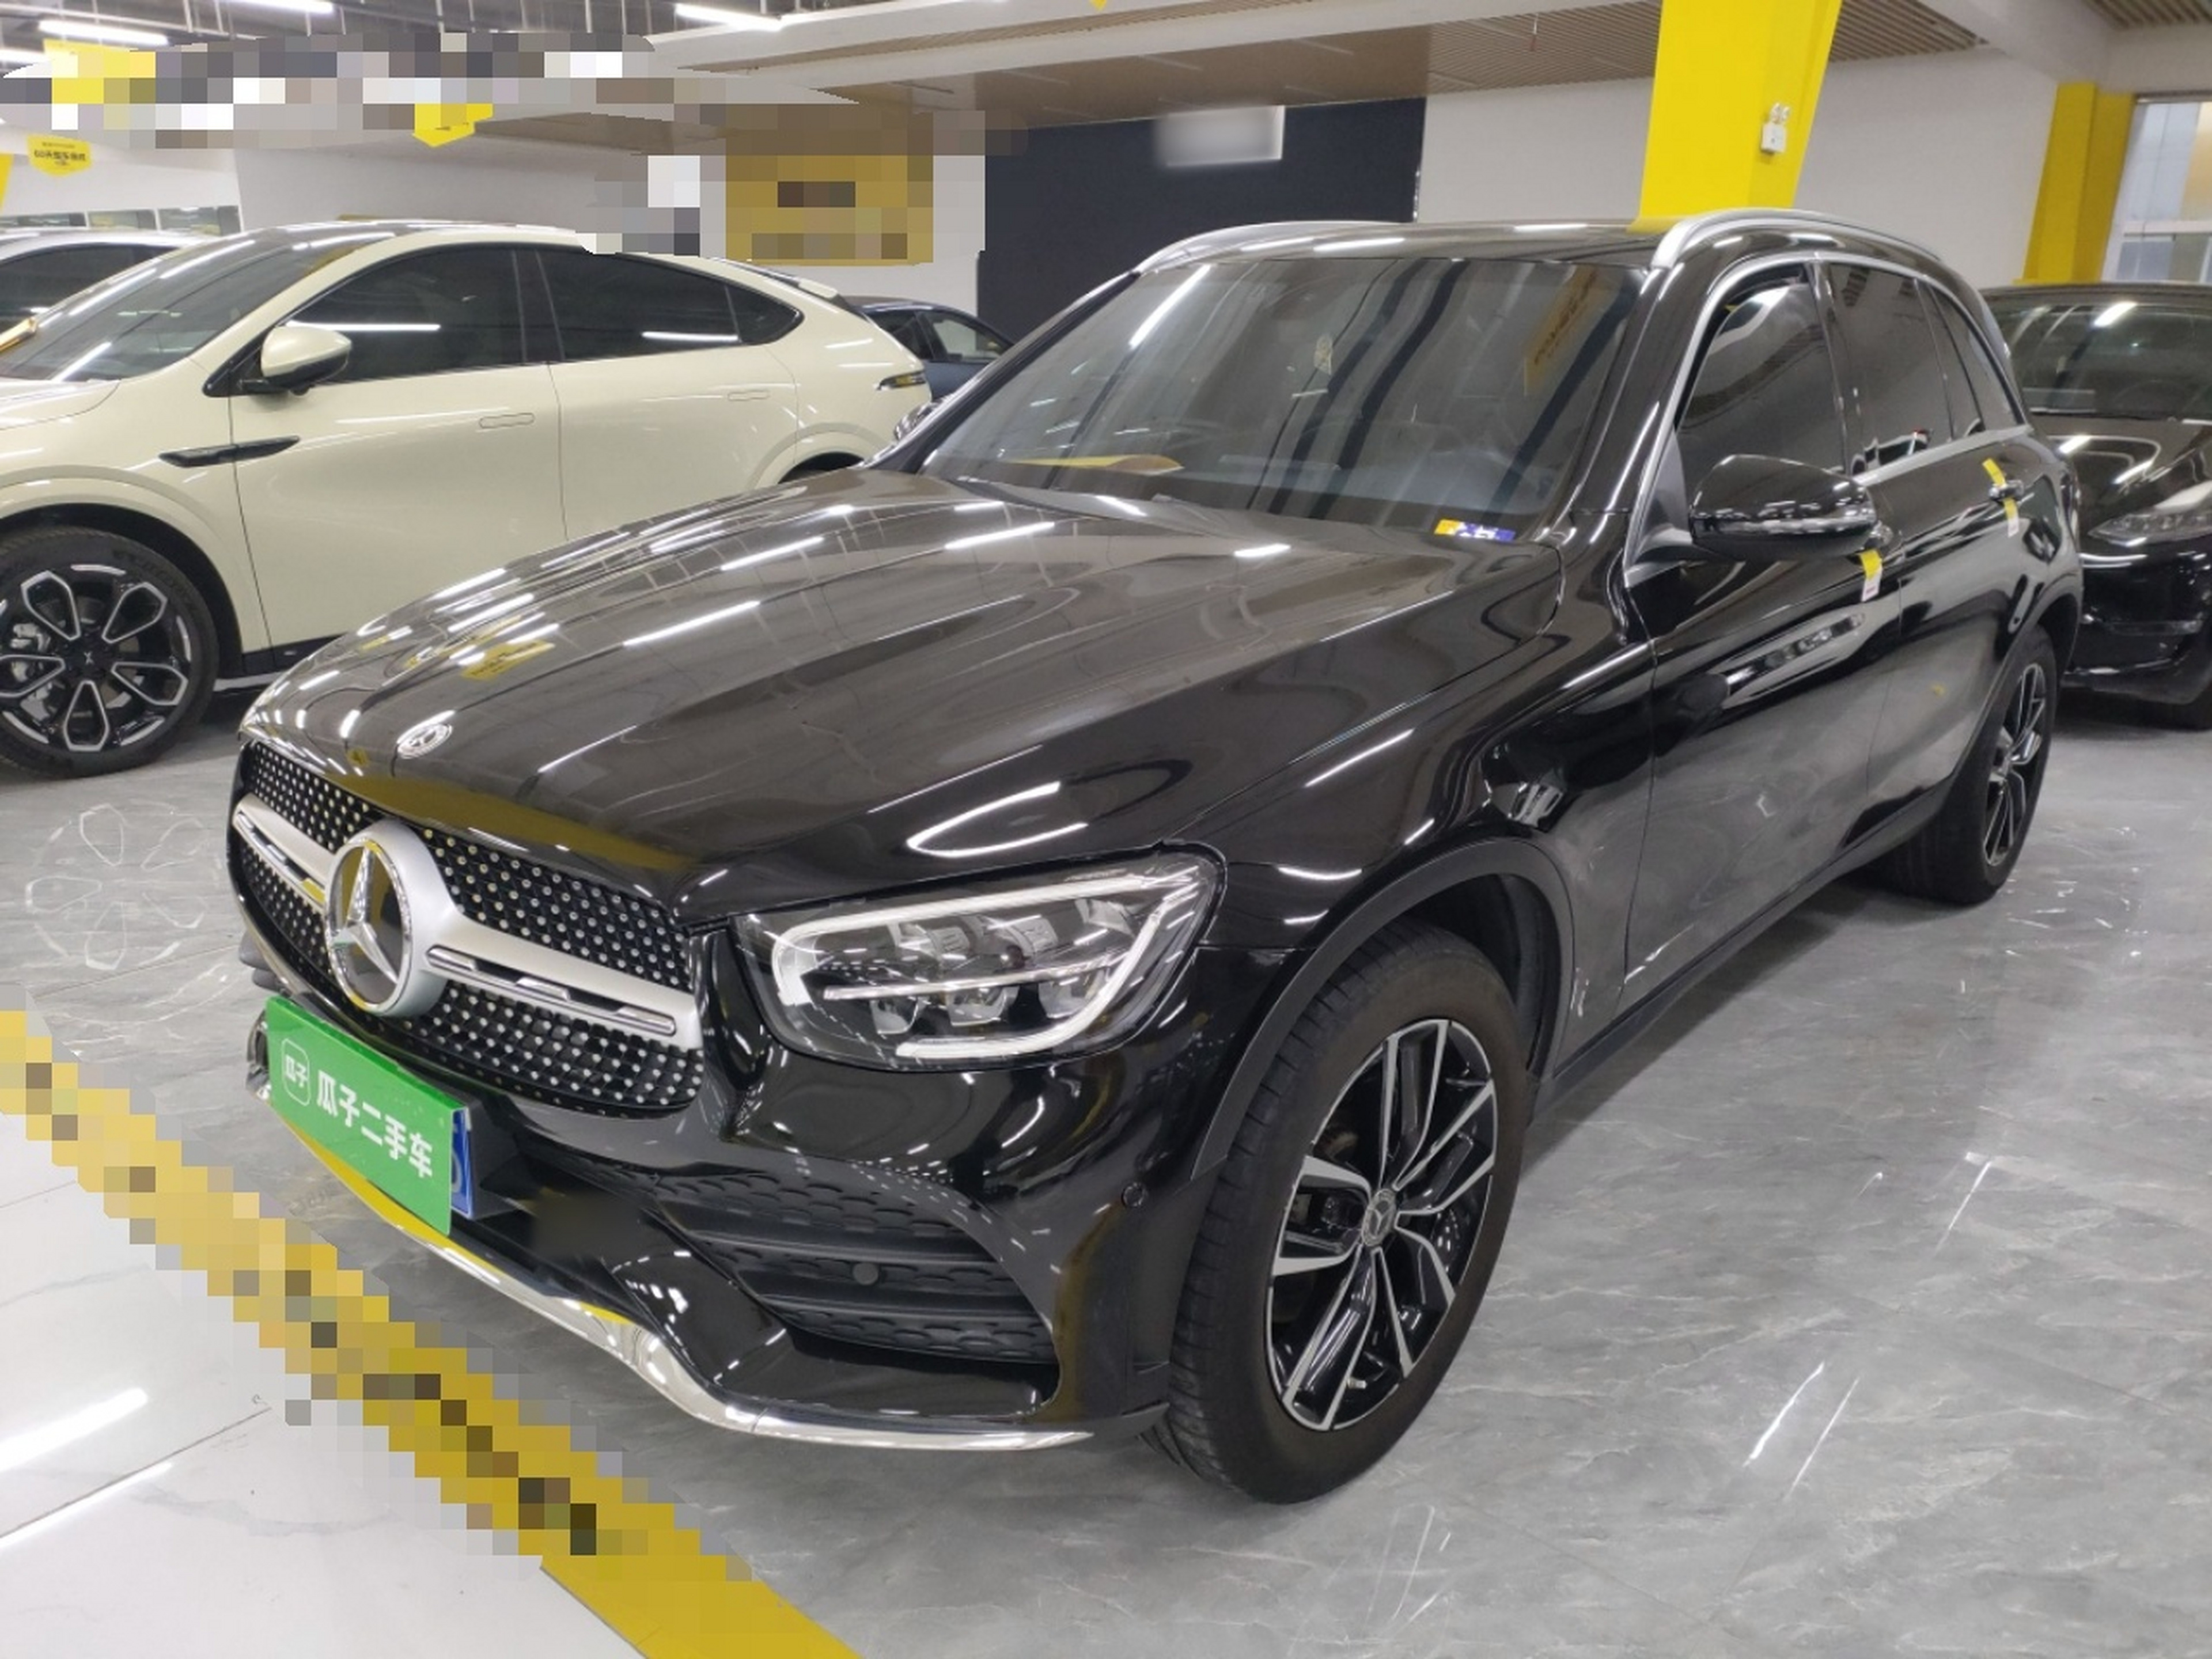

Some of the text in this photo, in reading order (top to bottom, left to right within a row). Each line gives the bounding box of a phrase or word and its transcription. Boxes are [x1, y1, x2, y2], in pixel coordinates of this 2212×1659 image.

[285, 1055, 308, 1088] 瓜子
[317, 1070, 433, 1178] 瓜子二手车
